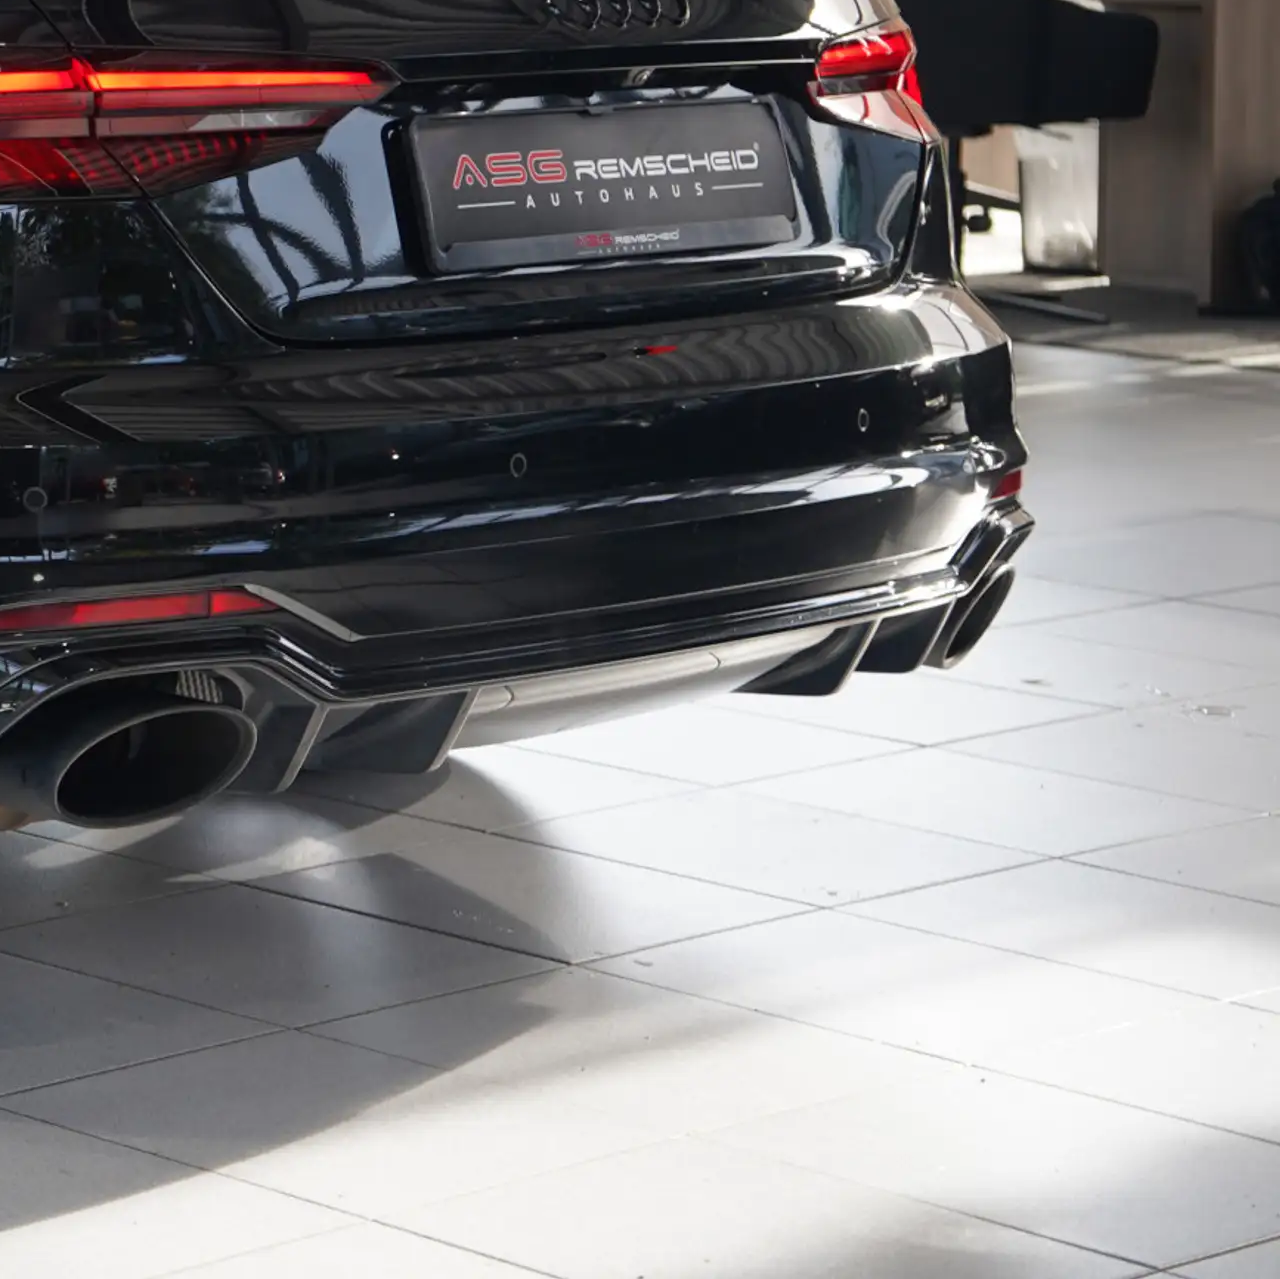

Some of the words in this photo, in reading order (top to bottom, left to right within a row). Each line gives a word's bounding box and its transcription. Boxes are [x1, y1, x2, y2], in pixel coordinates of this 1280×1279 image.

[453, 149, 567, 190] ASG
[573, 149, 759, 181] REMSCHEID
[526, 182, 704, 209] AUTOHAUS
